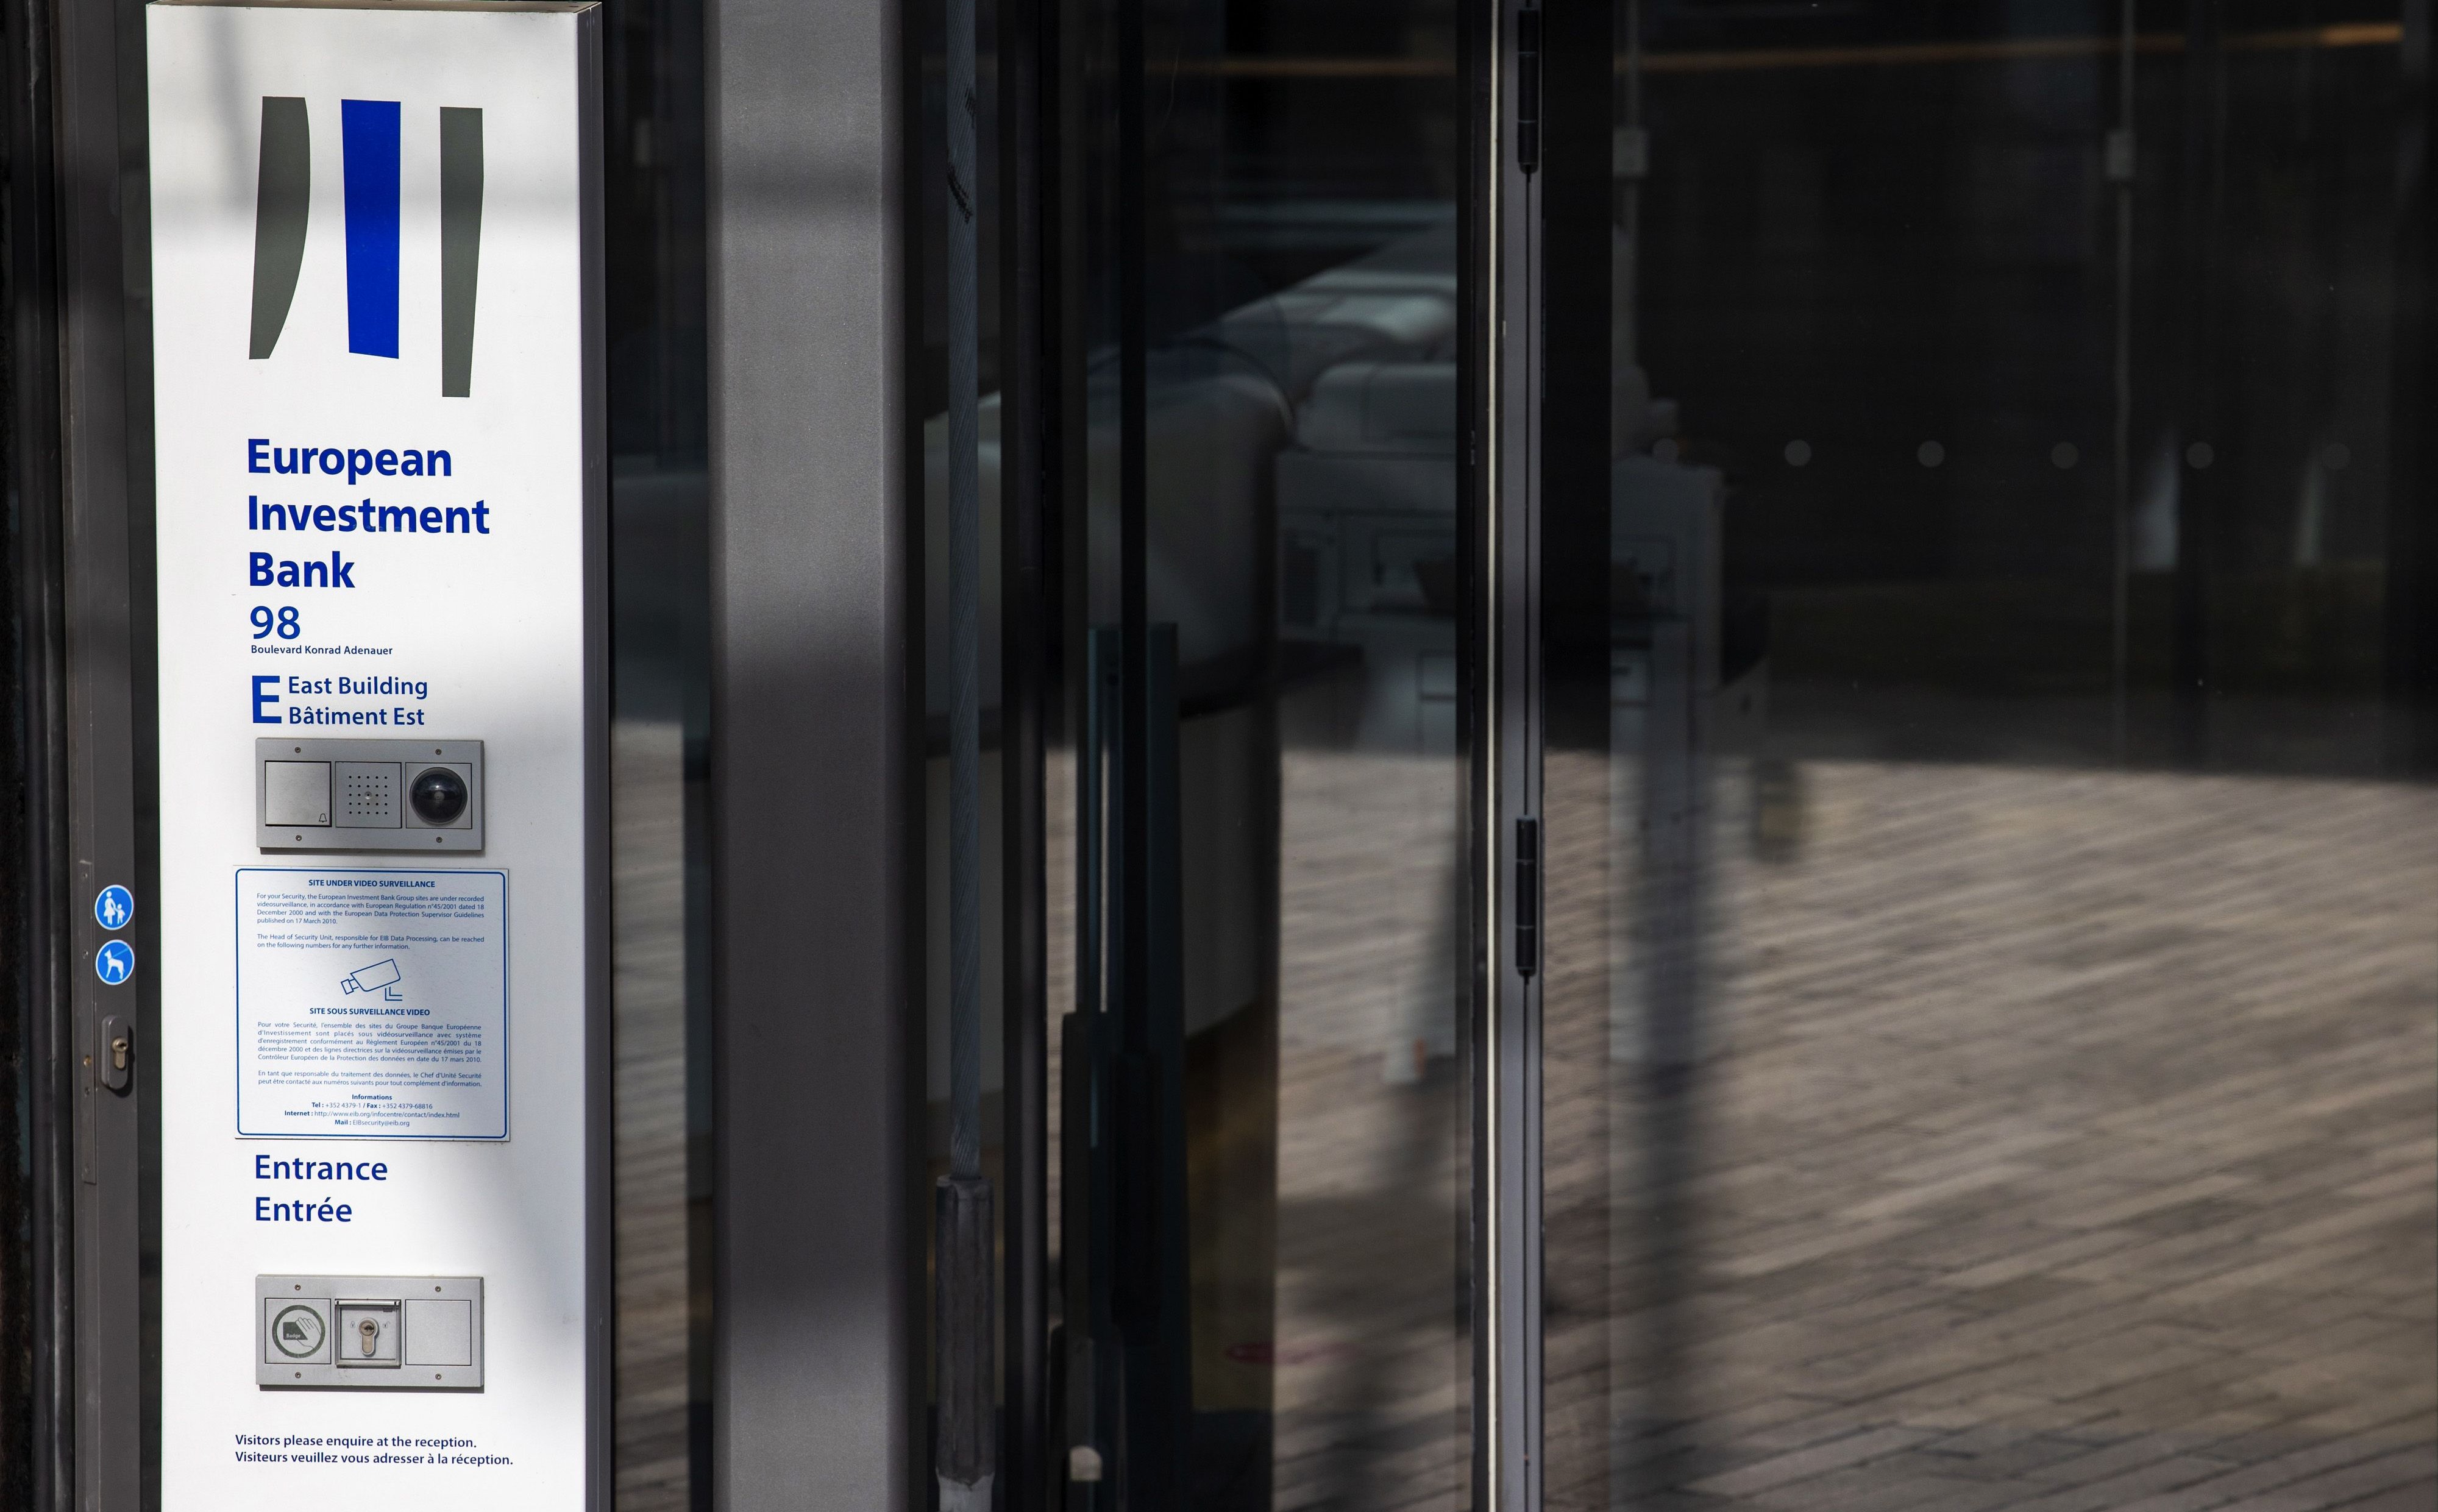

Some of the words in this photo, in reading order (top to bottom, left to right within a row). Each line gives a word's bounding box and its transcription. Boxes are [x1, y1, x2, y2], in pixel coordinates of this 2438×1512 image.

[247, 439, 452, 484] European
[249, 495, 489, 534] Investment
[249, 551, 355, 588] Bank
[250, 606, 300, 640] 98
[251, 645, 302, 654] Boulevard
[305, 646, 341, 655] Konrad
[344, 646, 393, 655] Adenauer
[252, 675, 282, 723] E
[289, 676, 332, 694] East
[339, 676, 427, 700] Building
[290, 706, 387, 725] Bâtiment
[394, 707, 425, 725] Est
[256, 1154, 388, 1180] Entrance
[256, 1196, 352, 1222] Entrée
[235, 1435, 280, 1445] Visitors
[284, 1435, 323, 1447] please
[326, 1436, 374, 1449] enquire
[377, 1437, 388, 1446] at
[391, 1436, 412, 1447] the
[415, 1437, 477, 1449] reception.
[235, 1452, 288, 1462] Visiteurs
[291, 1452, 338, 1463] veuillez
[373, 1453, 424, 1463] adresser
[427, 1453, 434, 1464] à
[438, 1453, 448, 1464] la
[452, 1454, 513, 1467] réception.
